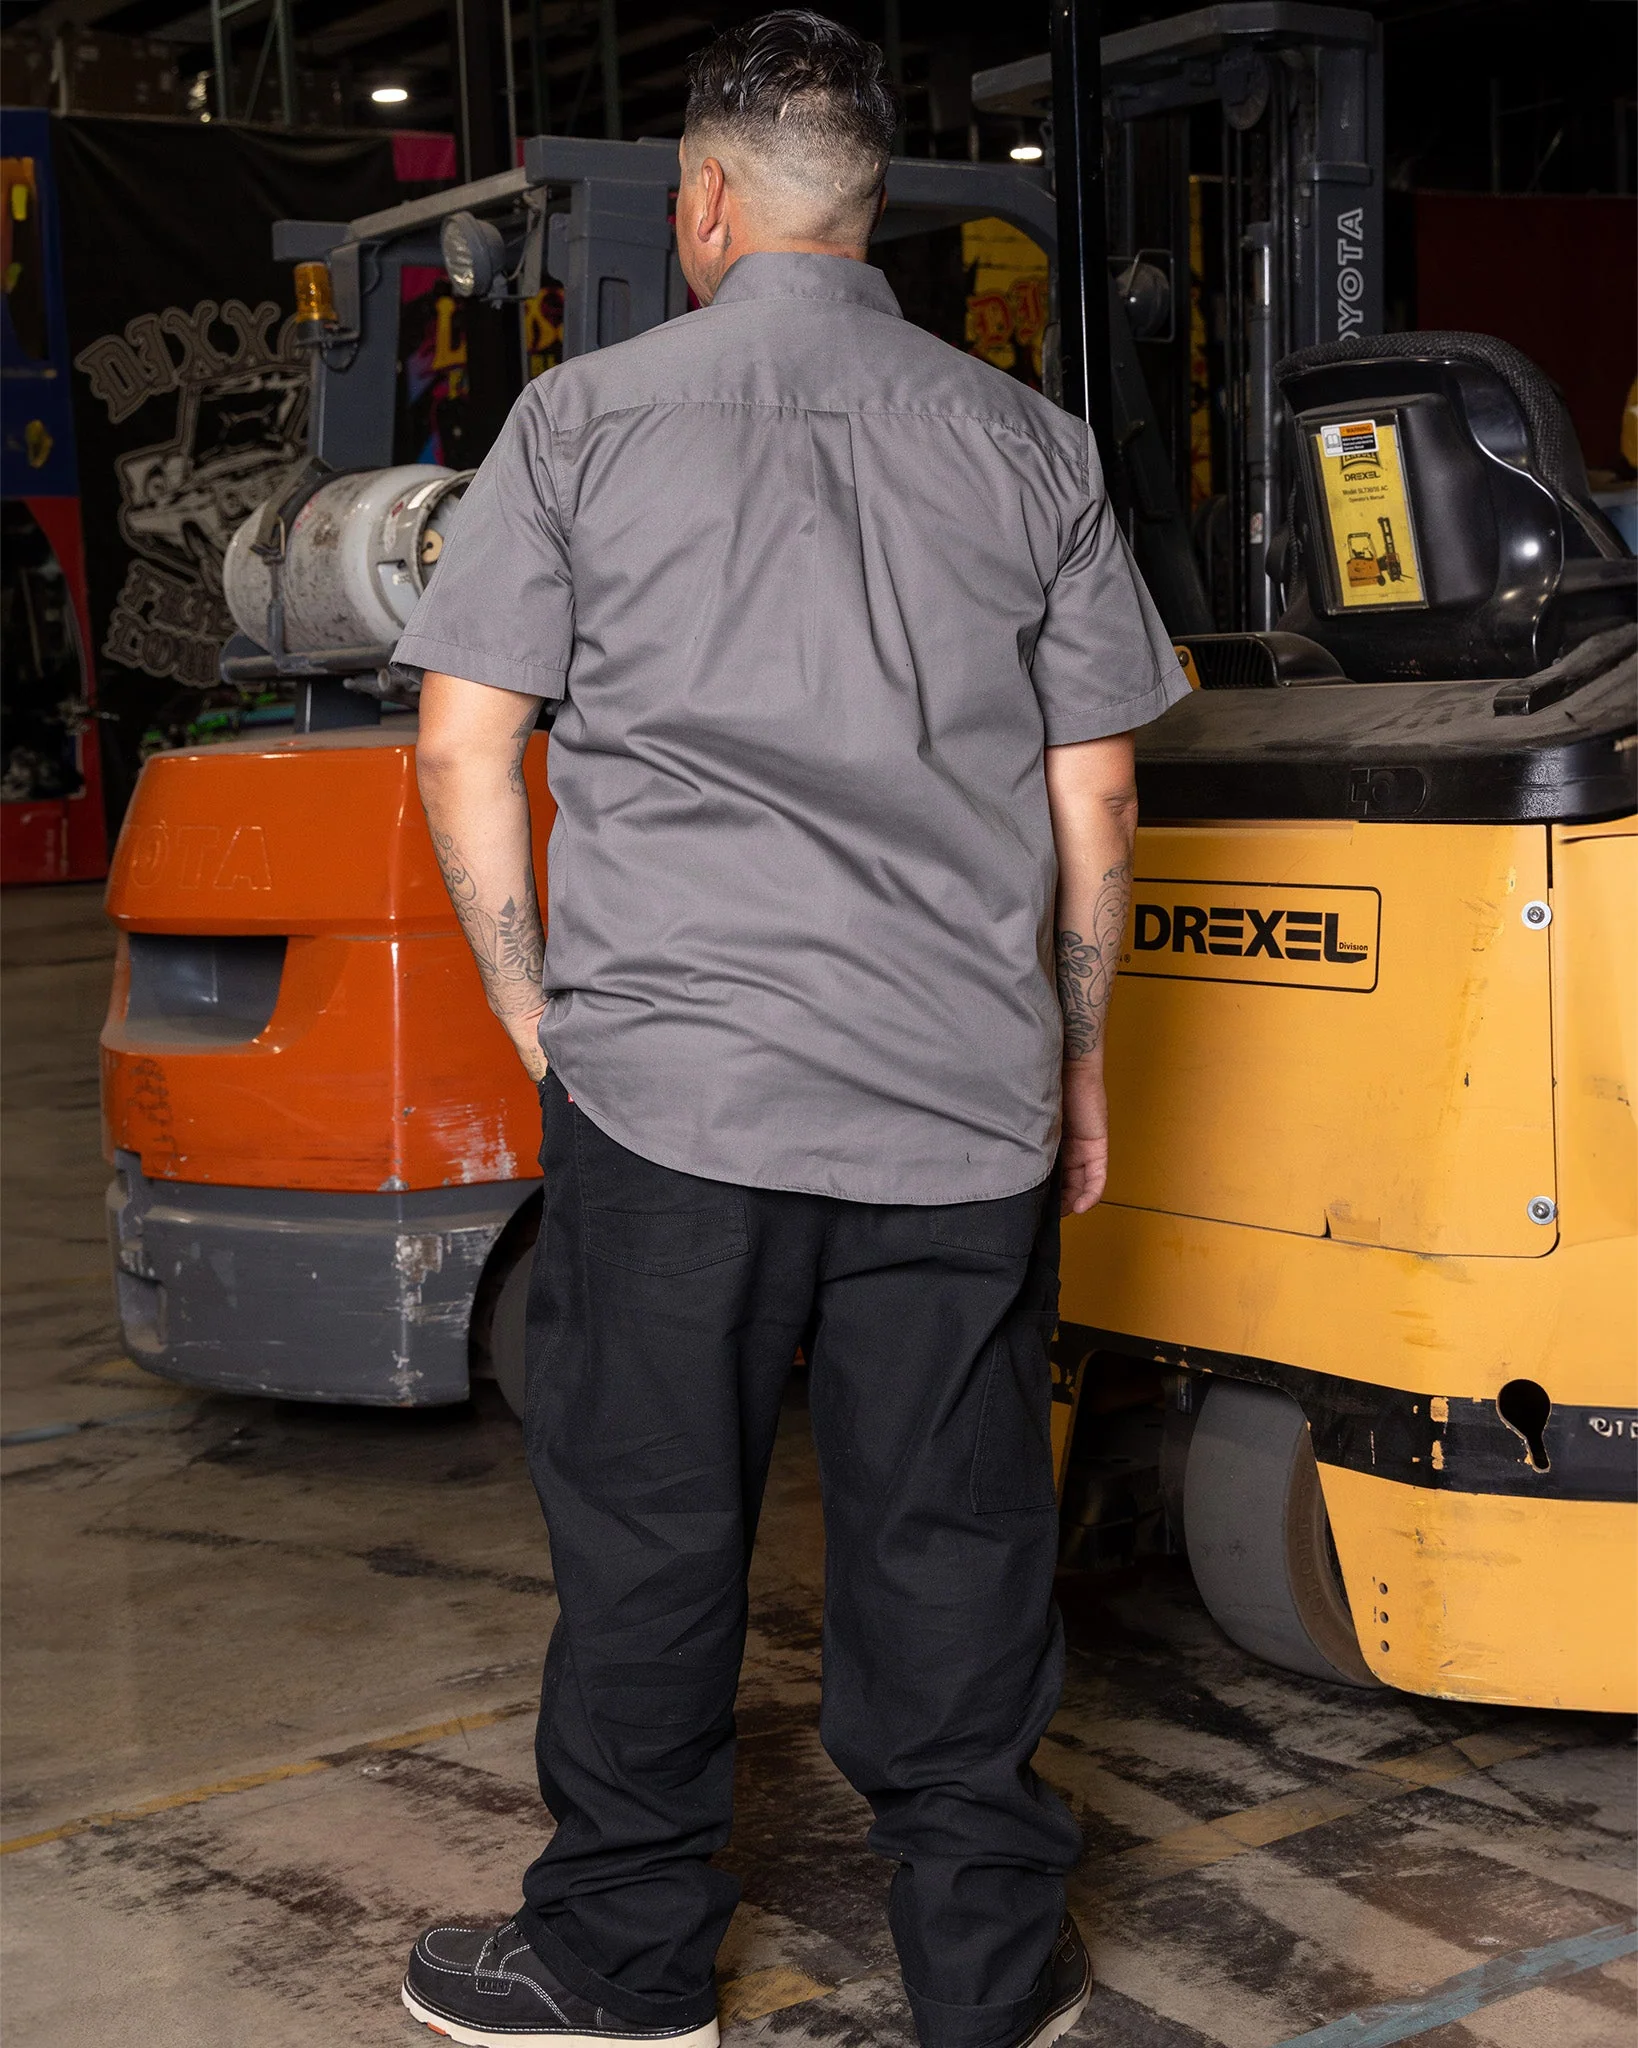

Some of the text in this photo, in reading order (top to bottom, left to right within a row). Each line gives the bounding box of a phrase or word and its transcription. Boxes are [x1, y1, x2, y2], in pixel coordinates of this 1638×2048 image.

[1344, 471, 1380, 482] DREXEL
[122, 822, 272, 890] OTA
[1134, 903, 1368, 964] DREXEL
[1338, 941, 1369, 952] Division
